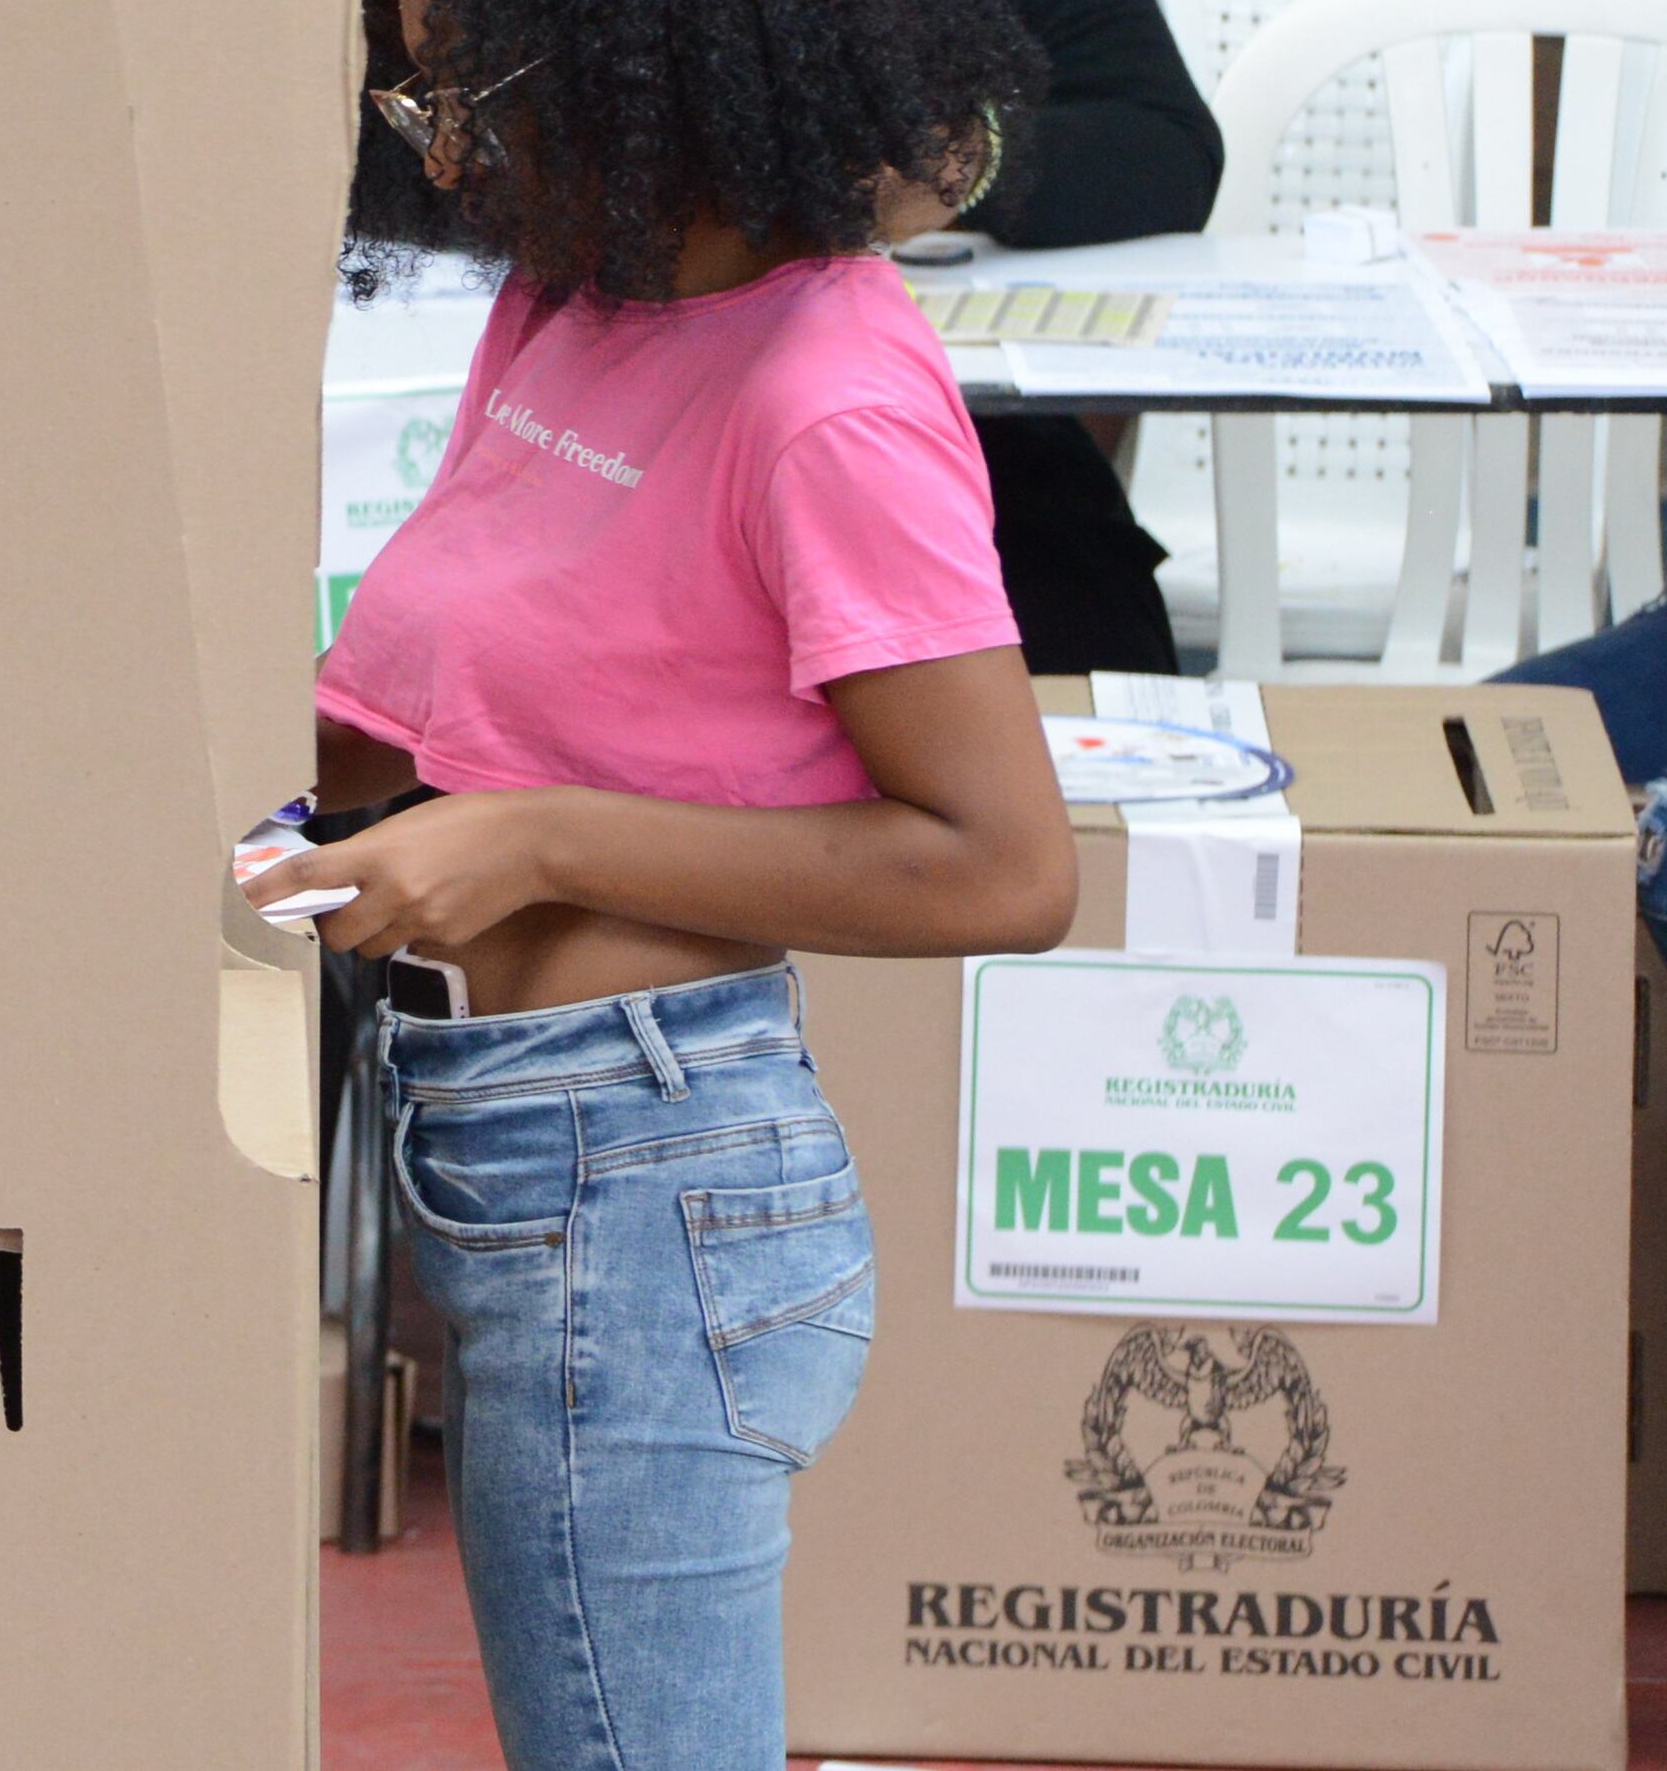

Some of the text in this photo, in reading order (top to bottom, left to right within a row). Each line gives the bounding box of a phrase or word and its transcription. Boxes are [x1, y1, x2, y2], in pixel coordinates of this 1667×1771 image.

[509, 404, 554, 450] More
[553, 429, 646, 489] Freedom
[1105, 1076, 1297, 1100] REGISTRADURÍA
[994, 1147, 1399, 1245] MESA 23
[1103, 1527, 1306, 1554] ORGANIZACIÓN ELECTORAL
[906, 1580, 1500, 1645] REGISTRADURÍA
[905, 1638, 1501, 1683] NACIONAL DEL ESTADO CIVIL
